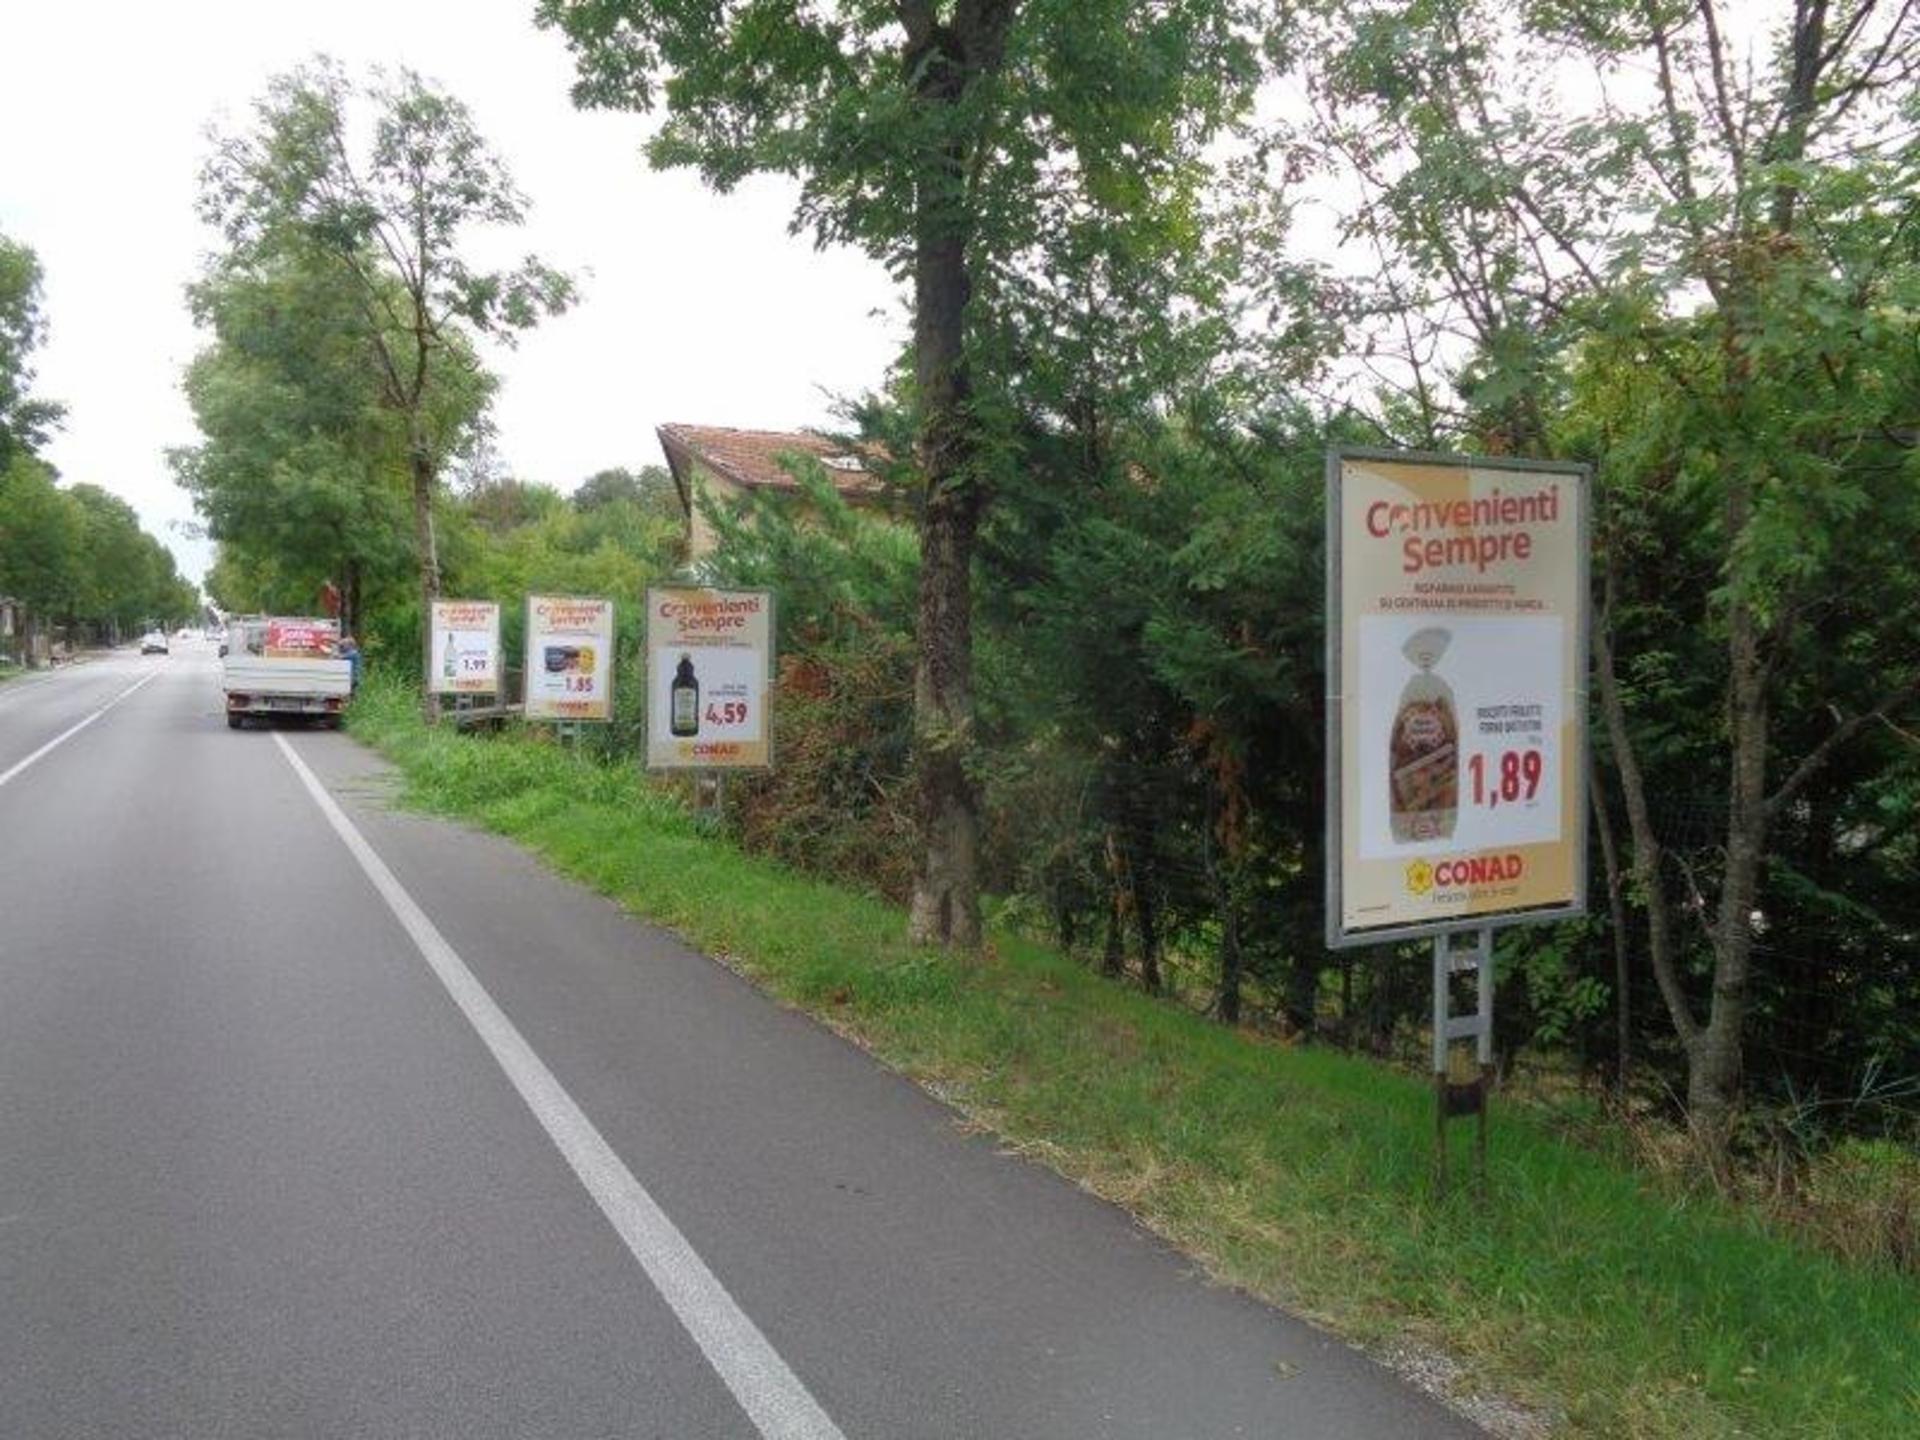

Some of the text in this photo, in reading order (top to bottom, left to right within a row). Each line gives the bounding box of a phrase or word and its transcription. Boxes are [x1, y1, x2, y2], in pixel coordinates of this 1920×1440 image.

[1366, 485, 1559, 538] Convenienti
[1403, 531, 1531, 573] Sempre
[660, 597, 760, 618] Convenienti
[678, 615, 745, 632] Sempre
[705, 702, 747, 726] 4,59
[1468, 750, 1541, 810] 1,89
[1434, 854, 1522, 886] CONAD
